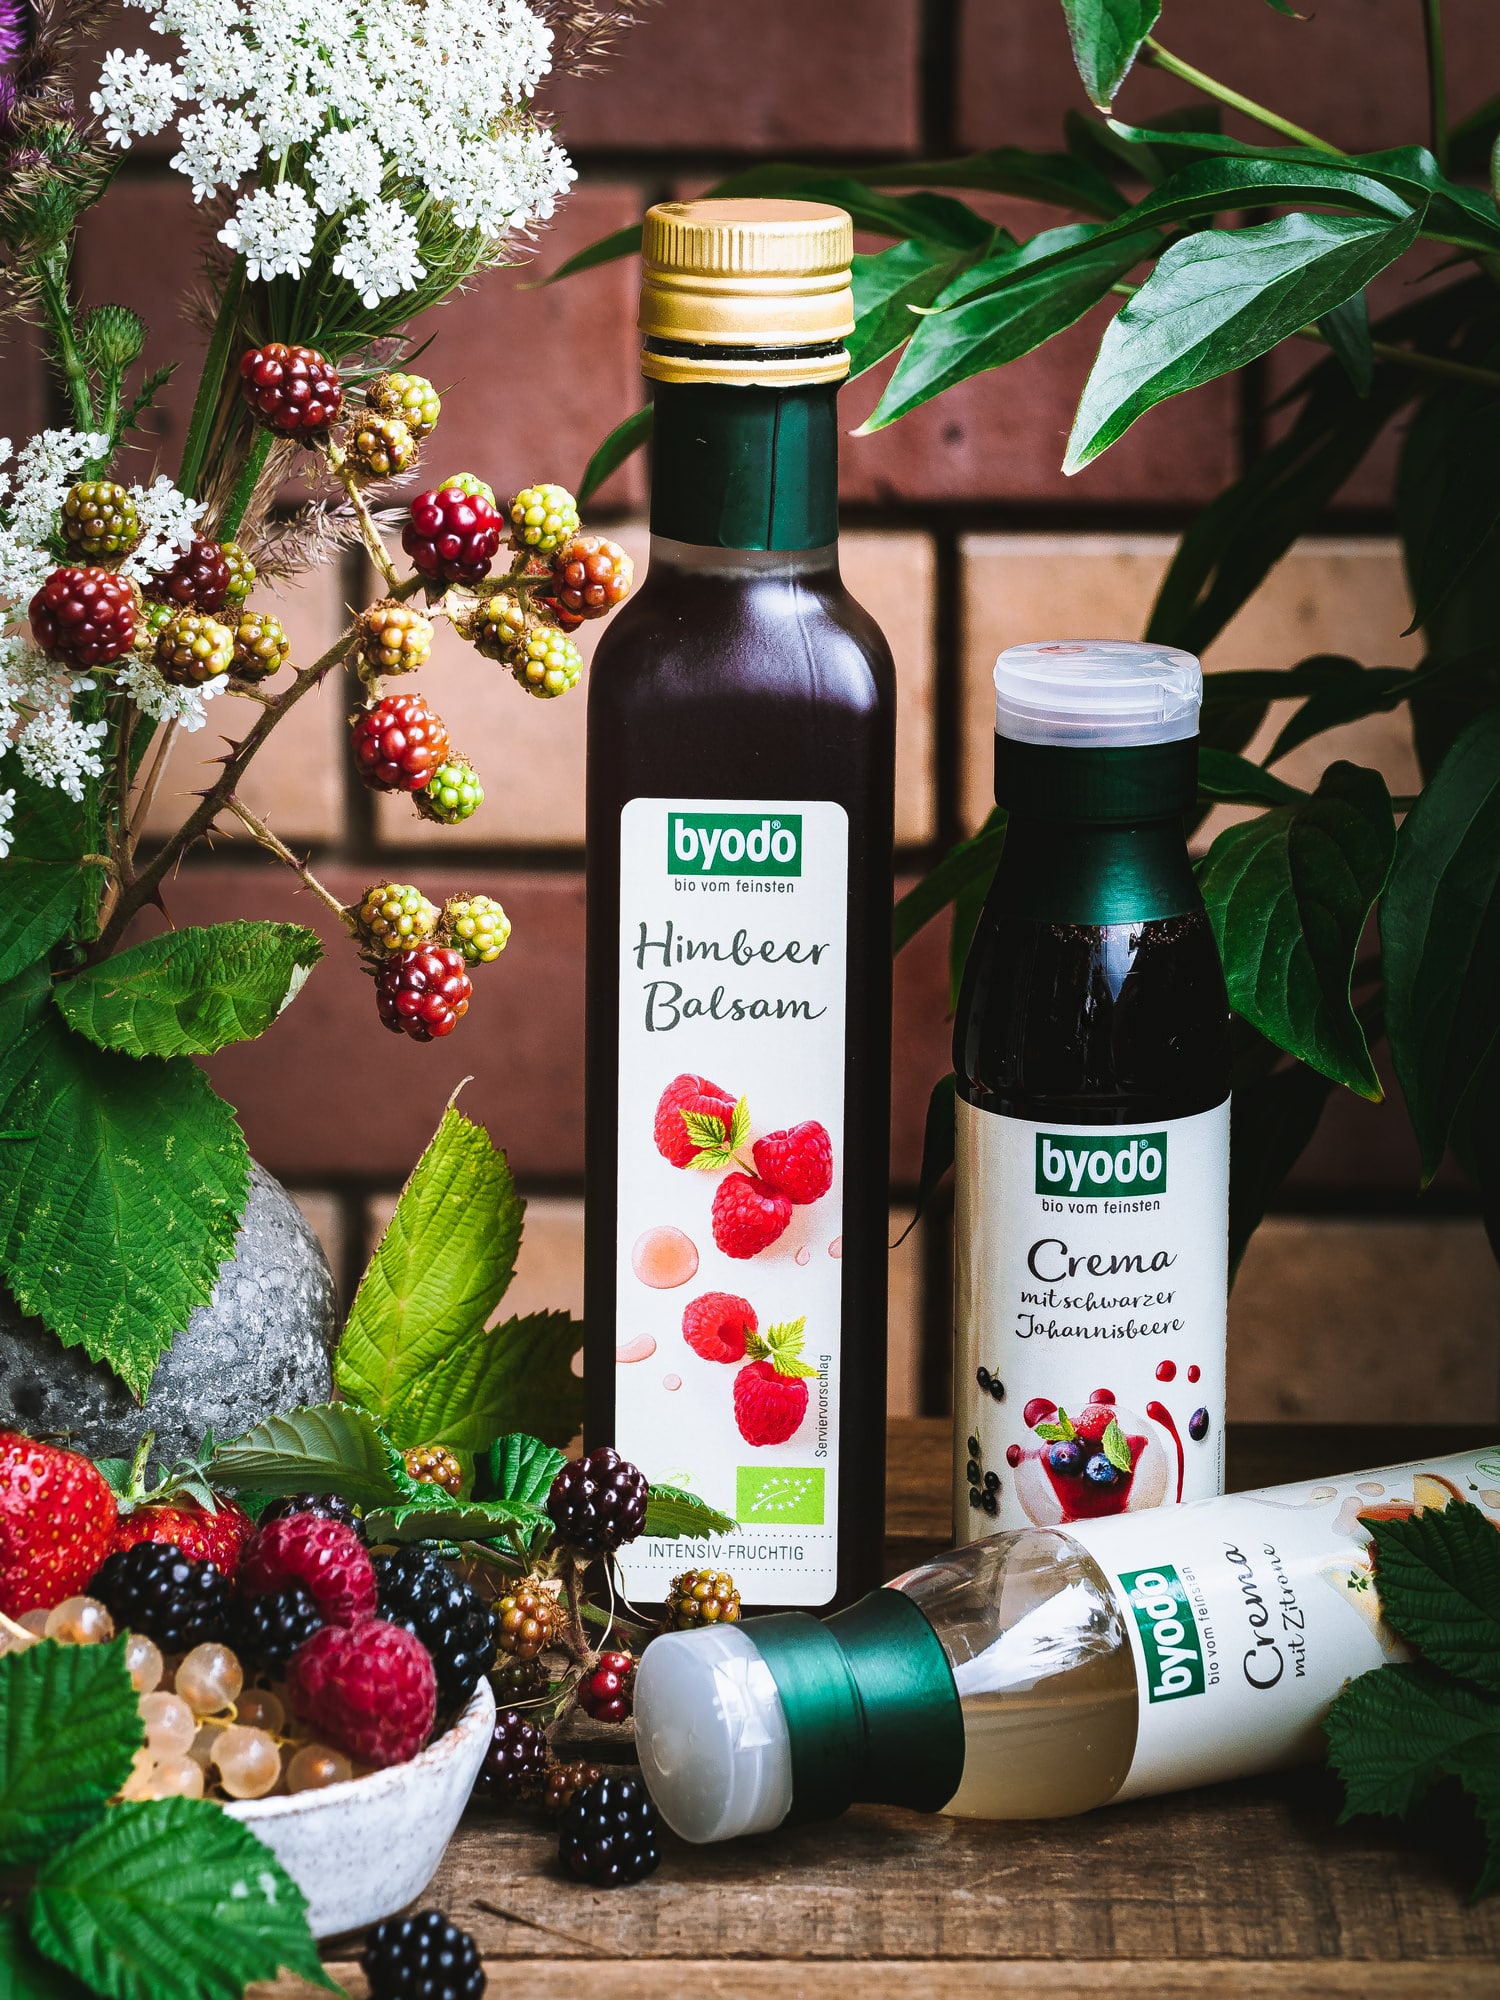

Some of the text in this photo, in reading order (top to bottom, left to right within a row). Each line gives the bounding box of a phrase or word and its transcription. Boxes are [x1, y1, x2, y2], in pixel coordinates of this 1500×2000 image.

[674, 878, 795, 894] bio vom feinsten
[633, 920, 830, 970] Himbeer
[643, 980, 828, 1032] Balsam
[1042, 1199, 1160, 1214] bio vom feinsten
[1027, 1238, 1178, 1282] Crema
[1015, 1313, 1185, 1339] Johannisbeere
[814, 1354, 832, 1458] Serviervorschlag
[648, 1543, 804, 1561] INTENSIV-FRUCHTIG
[1223, 1541, 1284, 1690] Crema
[1263, 1542, 1306, 1677] mit Zitrone
[1203, 1626, 1217, 1658] vom
[1207, 1661, 1220, 1685] bio
